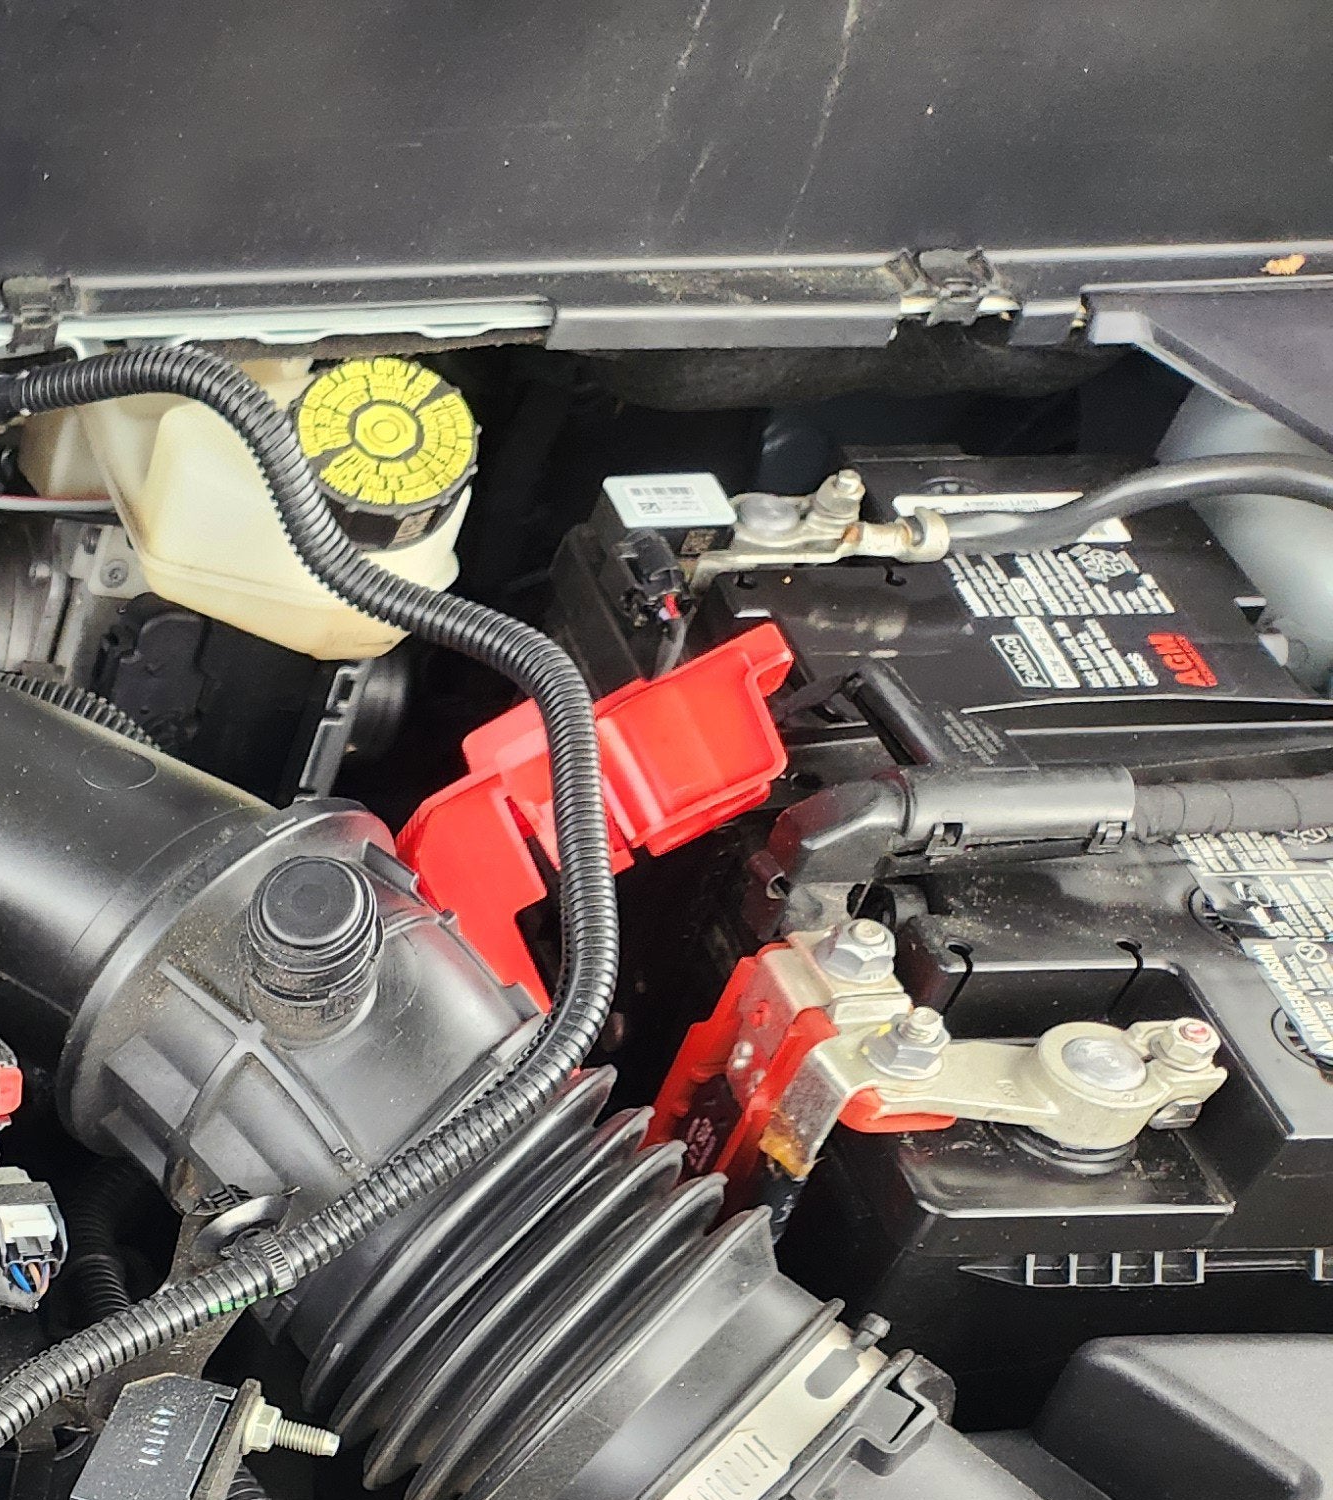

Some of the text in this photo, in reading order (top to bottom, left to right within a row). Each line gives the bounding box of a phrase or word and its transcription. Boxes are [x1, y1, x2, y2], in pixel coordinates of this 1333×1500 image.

[1001, 635, 1042, 684] FoMoCo
[1148, 633, 1204, 685] AGM
[1253, 943, 1332, 1042] DANGER/POISON
